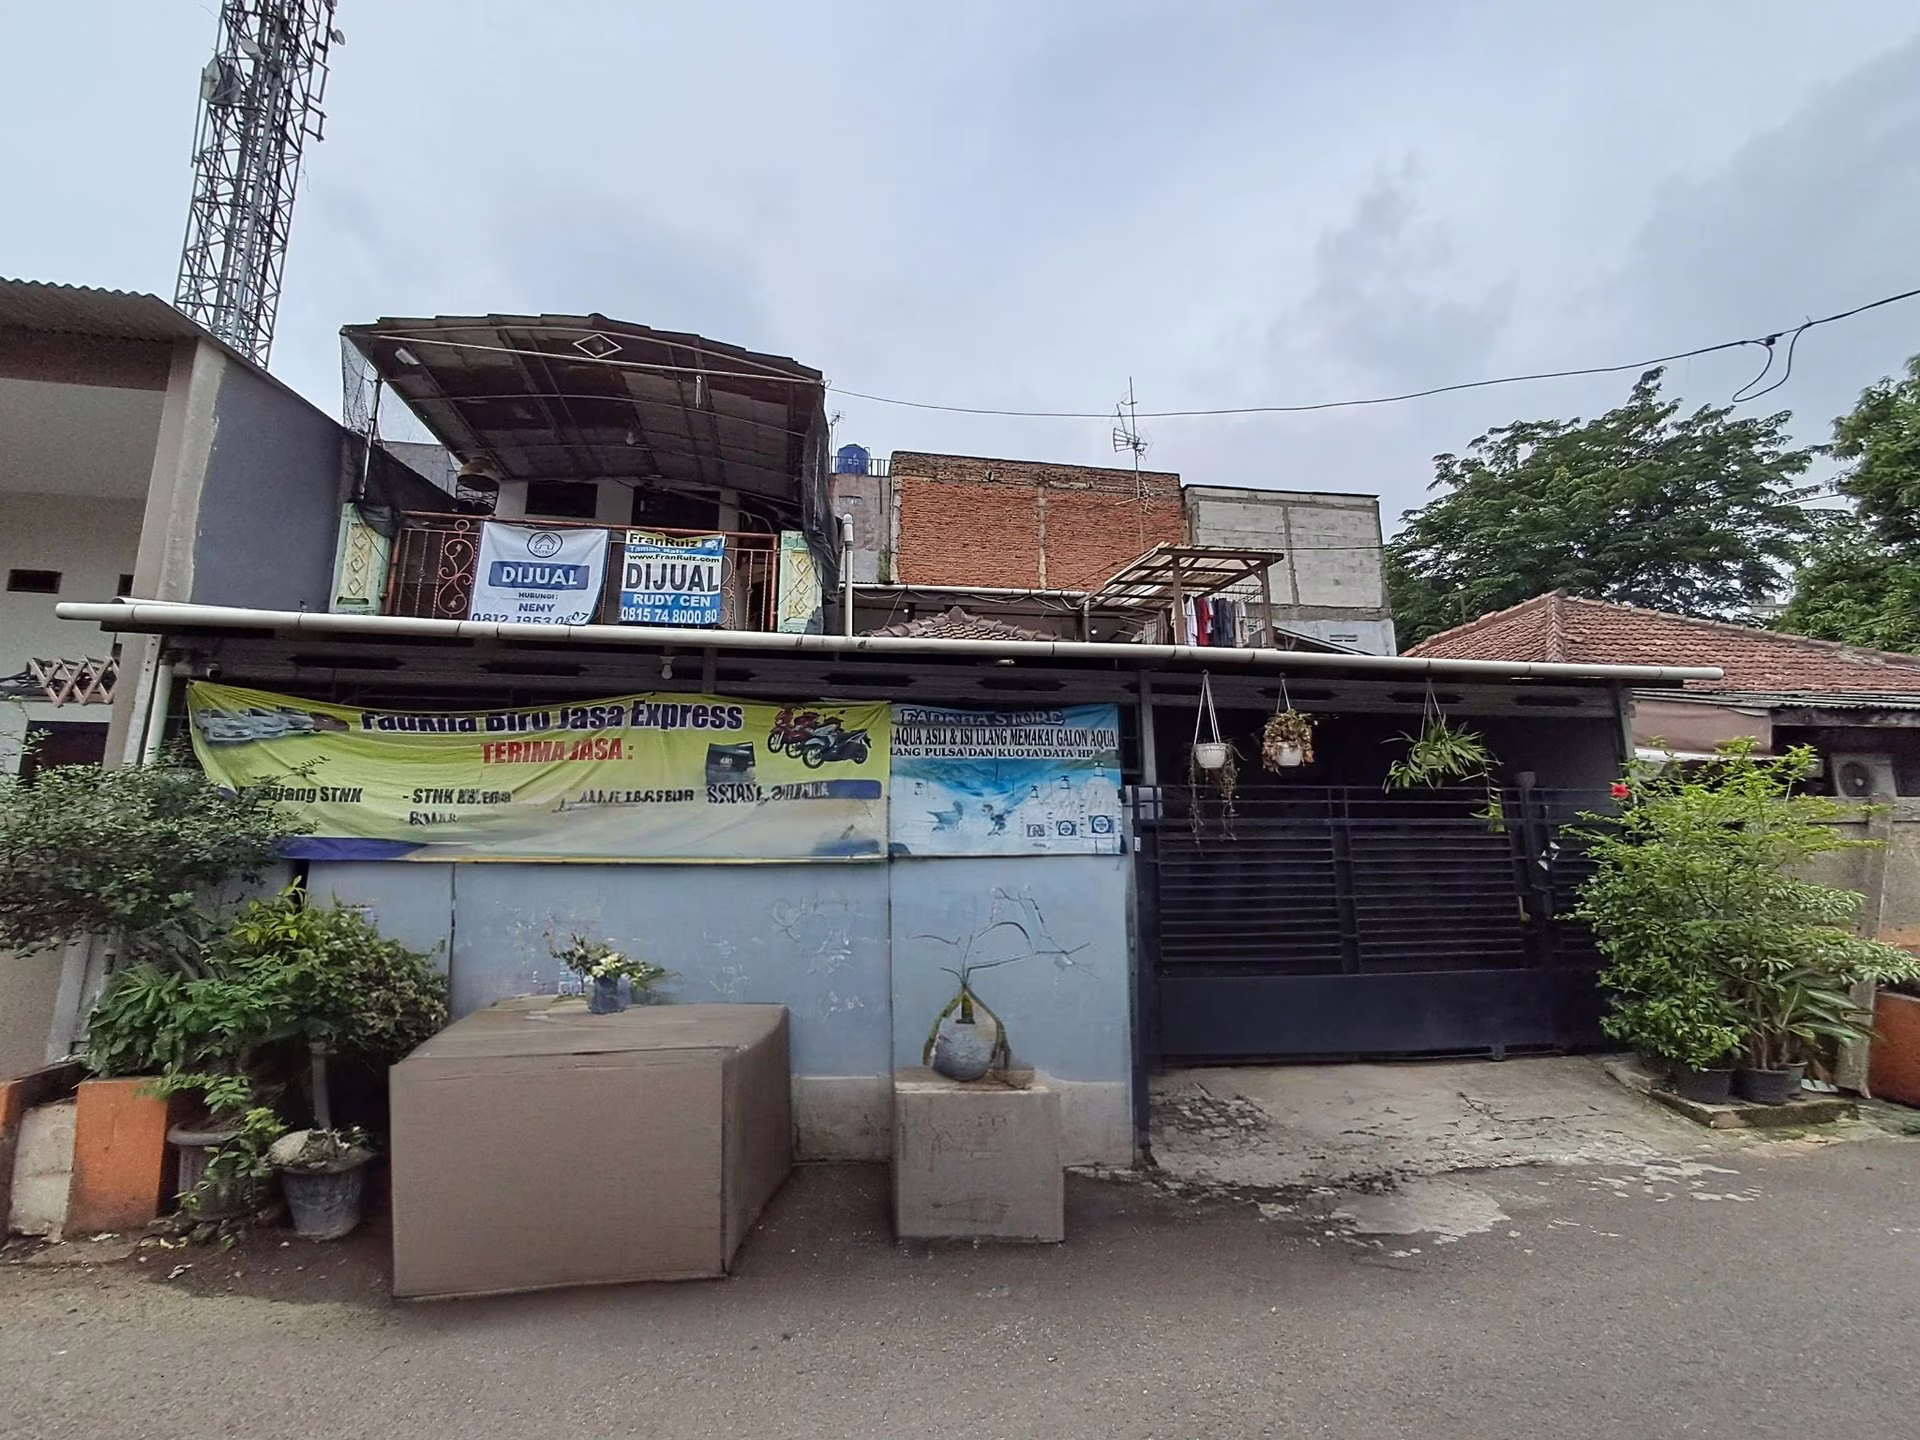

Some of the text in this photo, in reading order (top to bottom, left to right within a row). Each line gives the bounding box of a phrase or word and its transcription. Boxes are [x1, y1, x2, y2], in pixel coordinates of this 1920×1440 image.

[629, 533, 699, 548] FranRuiz
[629, 554, 720, 563] www.FranRuiz.com
[502, 566, 578, 585] DIJUAL
[625, 563, 720, 592] DIJUAL
[518, 603, 556, 612] NENY
[633, 594, 711, 607] RUDY CEN
[472, 613, 509, 623] 0812
[621, 607, 718, 623] 0815 74 8000 80
[558, 705, 626, 729] Jasa
[631, 699, 743, 730] Express
[994, 711, 1066, 727] STORE
[894, 727, 1115, 750] AQUA ASLI & ISI ULANG MEMAKAI GALON AQUA
[481, 740, 565, 763] TERIMA
[569, 738, 623, 761] JASA
[890, 747, 1094, 758] LANG PULSA DAN KUOTA DATA HP
[320, 786, 363, 803] STNK
